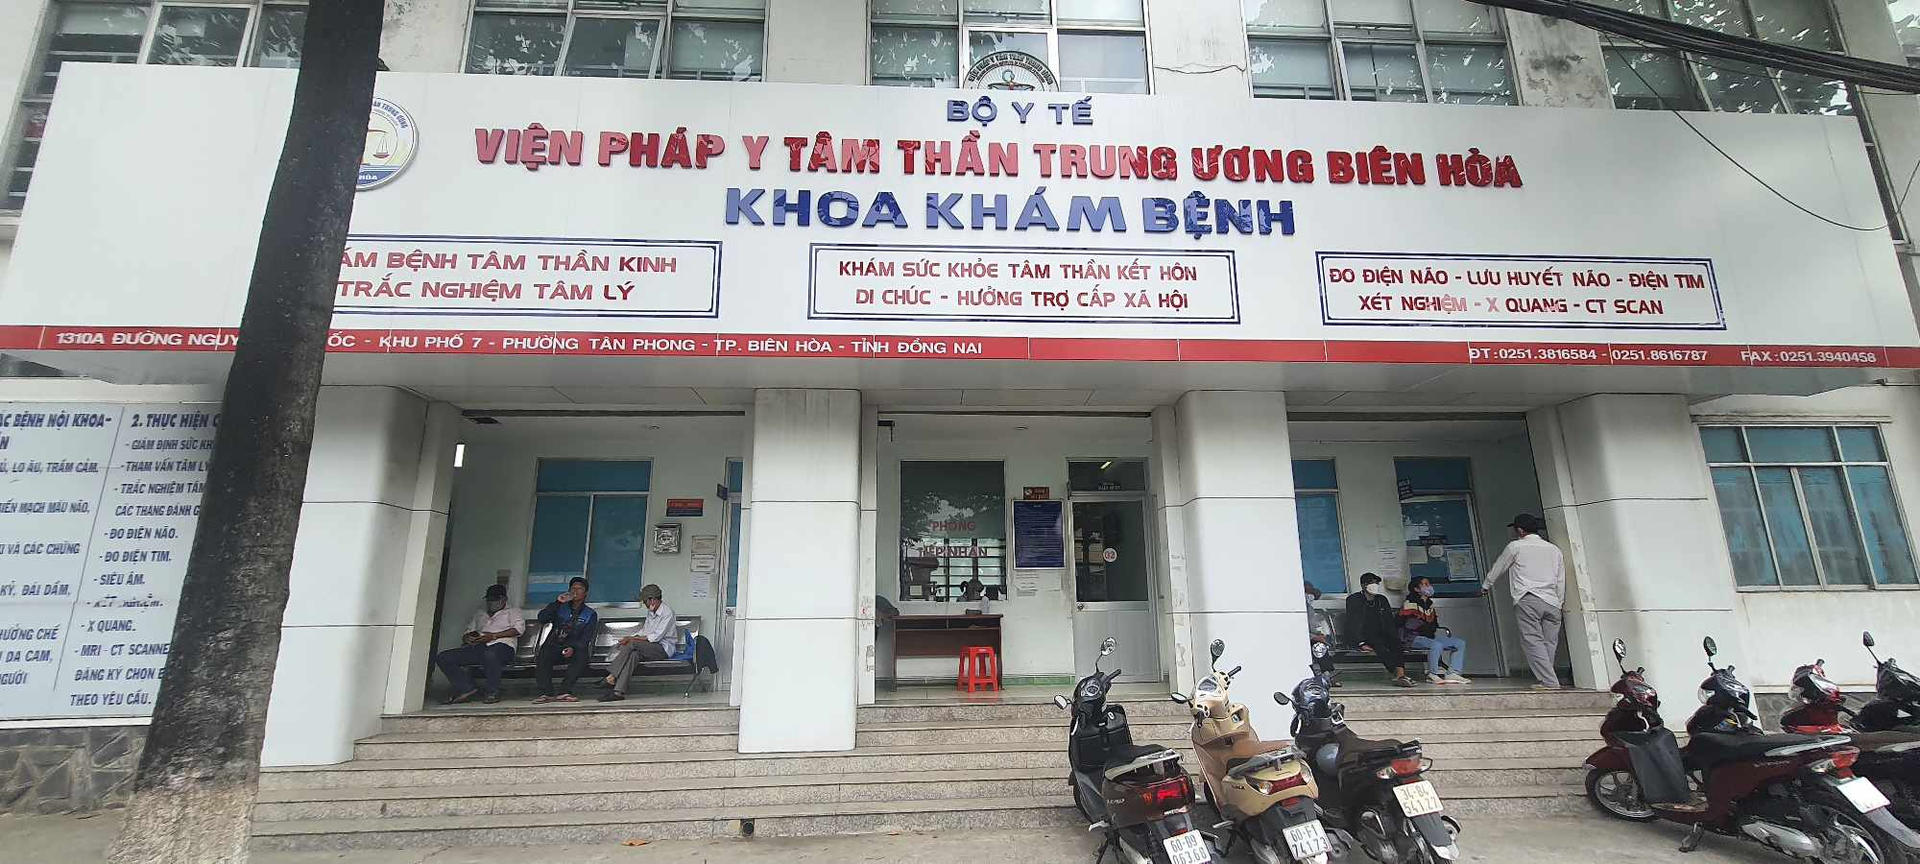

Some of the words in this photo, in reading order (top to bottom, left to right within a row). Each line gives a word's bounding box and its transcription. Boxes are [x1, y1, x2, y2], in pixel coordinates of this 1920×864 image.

[946, 95, 998, 127] BỘ
[1011, 101, 1035, 124] Y
[1047, 95, 1093, 125] TẾ
[475, 122, 584, 171] VIỆN
[598, 127, 726, 170] PHÁP
[742, 135, 770, 170] Y
[783, 131, 880, 173] TÂM
[897, 130, 1019, 178] THẦN
[1033, 143, 1178, 182] TRUNG
[1191, 144, 1315, 184] ƯƠNG
[1326, 145, 1426, 186] BIÊN
[1435, 147, 1524, 188] HÒA
[725, 187, 909, 229] KHOA
[926, 186, 1127, 233] KHÁM
[1141, 190, 1295, 240] BỆNH
[387, 249, 458, 272] BỆNH
[467, 250, 526, 271] TÂM
[538, 249, 610, 272] THẦN
[619, 256, 677, 273] KINH
[839, 258, 895, 277] KHÁM
[902, 259, 941, 278] SỨC
[948, 258, 998, 278] KHỎE
[1008, 259, 1051, 279] TÂM
[1060, 258, 1110, 281] THẦN
[1117, 258, 1152, 281] KẾT
[1160, 262, 1197, 281] HÔN
[338, 272, 412, 298] TRẮC
[421, 279, 522, 302] NGHIỆM
[533, 280, 593, 300] TÂM
[603, 280, 635, 301] LÝ
[1329, 268, 1355, 284] ĐO
[1362, 266, 1404, 287] ĐIỆN
[1410, 267, 1449, 285] NÃO
[1467, 269, 1501, 286] LƯU
[1507, 266, 1563, 287] HUYẾT
[1573, 270, 1611, 287] NÃO
[1629, 271, 1669, 290] ĐIỆN
[1674, 274, 1705, 289] TIM
[856, 289, 875, 304] DI
[882, 286, 932, 305] CHÚC
[957, 286, 1022, 306] HƯỞNG
[1031, 290, 1070, 311] TRỢ
[1077, 284, 1116, 308] CẤP
[1124, 290, 1152, 308] XÃ
[1158, 290, 1189, 312] HỘI
[1358, 292, 1393, 311] XÉT
[1401, 294, 1468, 314] NGHIỆM
[1486, 297, 1500, 312] X
[1505, 298, 1568, 313] QUANG
[1585, 299, 1607, 314] CT
[1614, 299, 1664, 315] SCAN
[56, 332, 105, 345] 1310A
[111, 329, 184, 346] ĐƯỜNG
[379, 336, 418, 349] KHU
[425, 332, 464, 349] PHỐ
[472, 337, 483, 349] 7
[503, 335, 579, 350] PHƯỜNG
[588, 337, 626, 351] TÂN
[633, 339, 695, 351] PHONG
[714, 339, 742, 352] TP.
[748, 338, 788, 353] BIÊN
[796, 338, 832, 352] HÒA
[851, 337, 889, 353] TỈNH
[897, 336, 947, 354] ĐỒNG
[954, 342, 982, 354] NAI
[1612, 349, 1708, 361] 0251.8616787
[131, 413, 142, 428] 2.
[87, 620, 96, 632] X
[80, 644, 102, 656] MRI
[110, 644, 125, 656] CT
[70, 694, 98, 706] THEO
